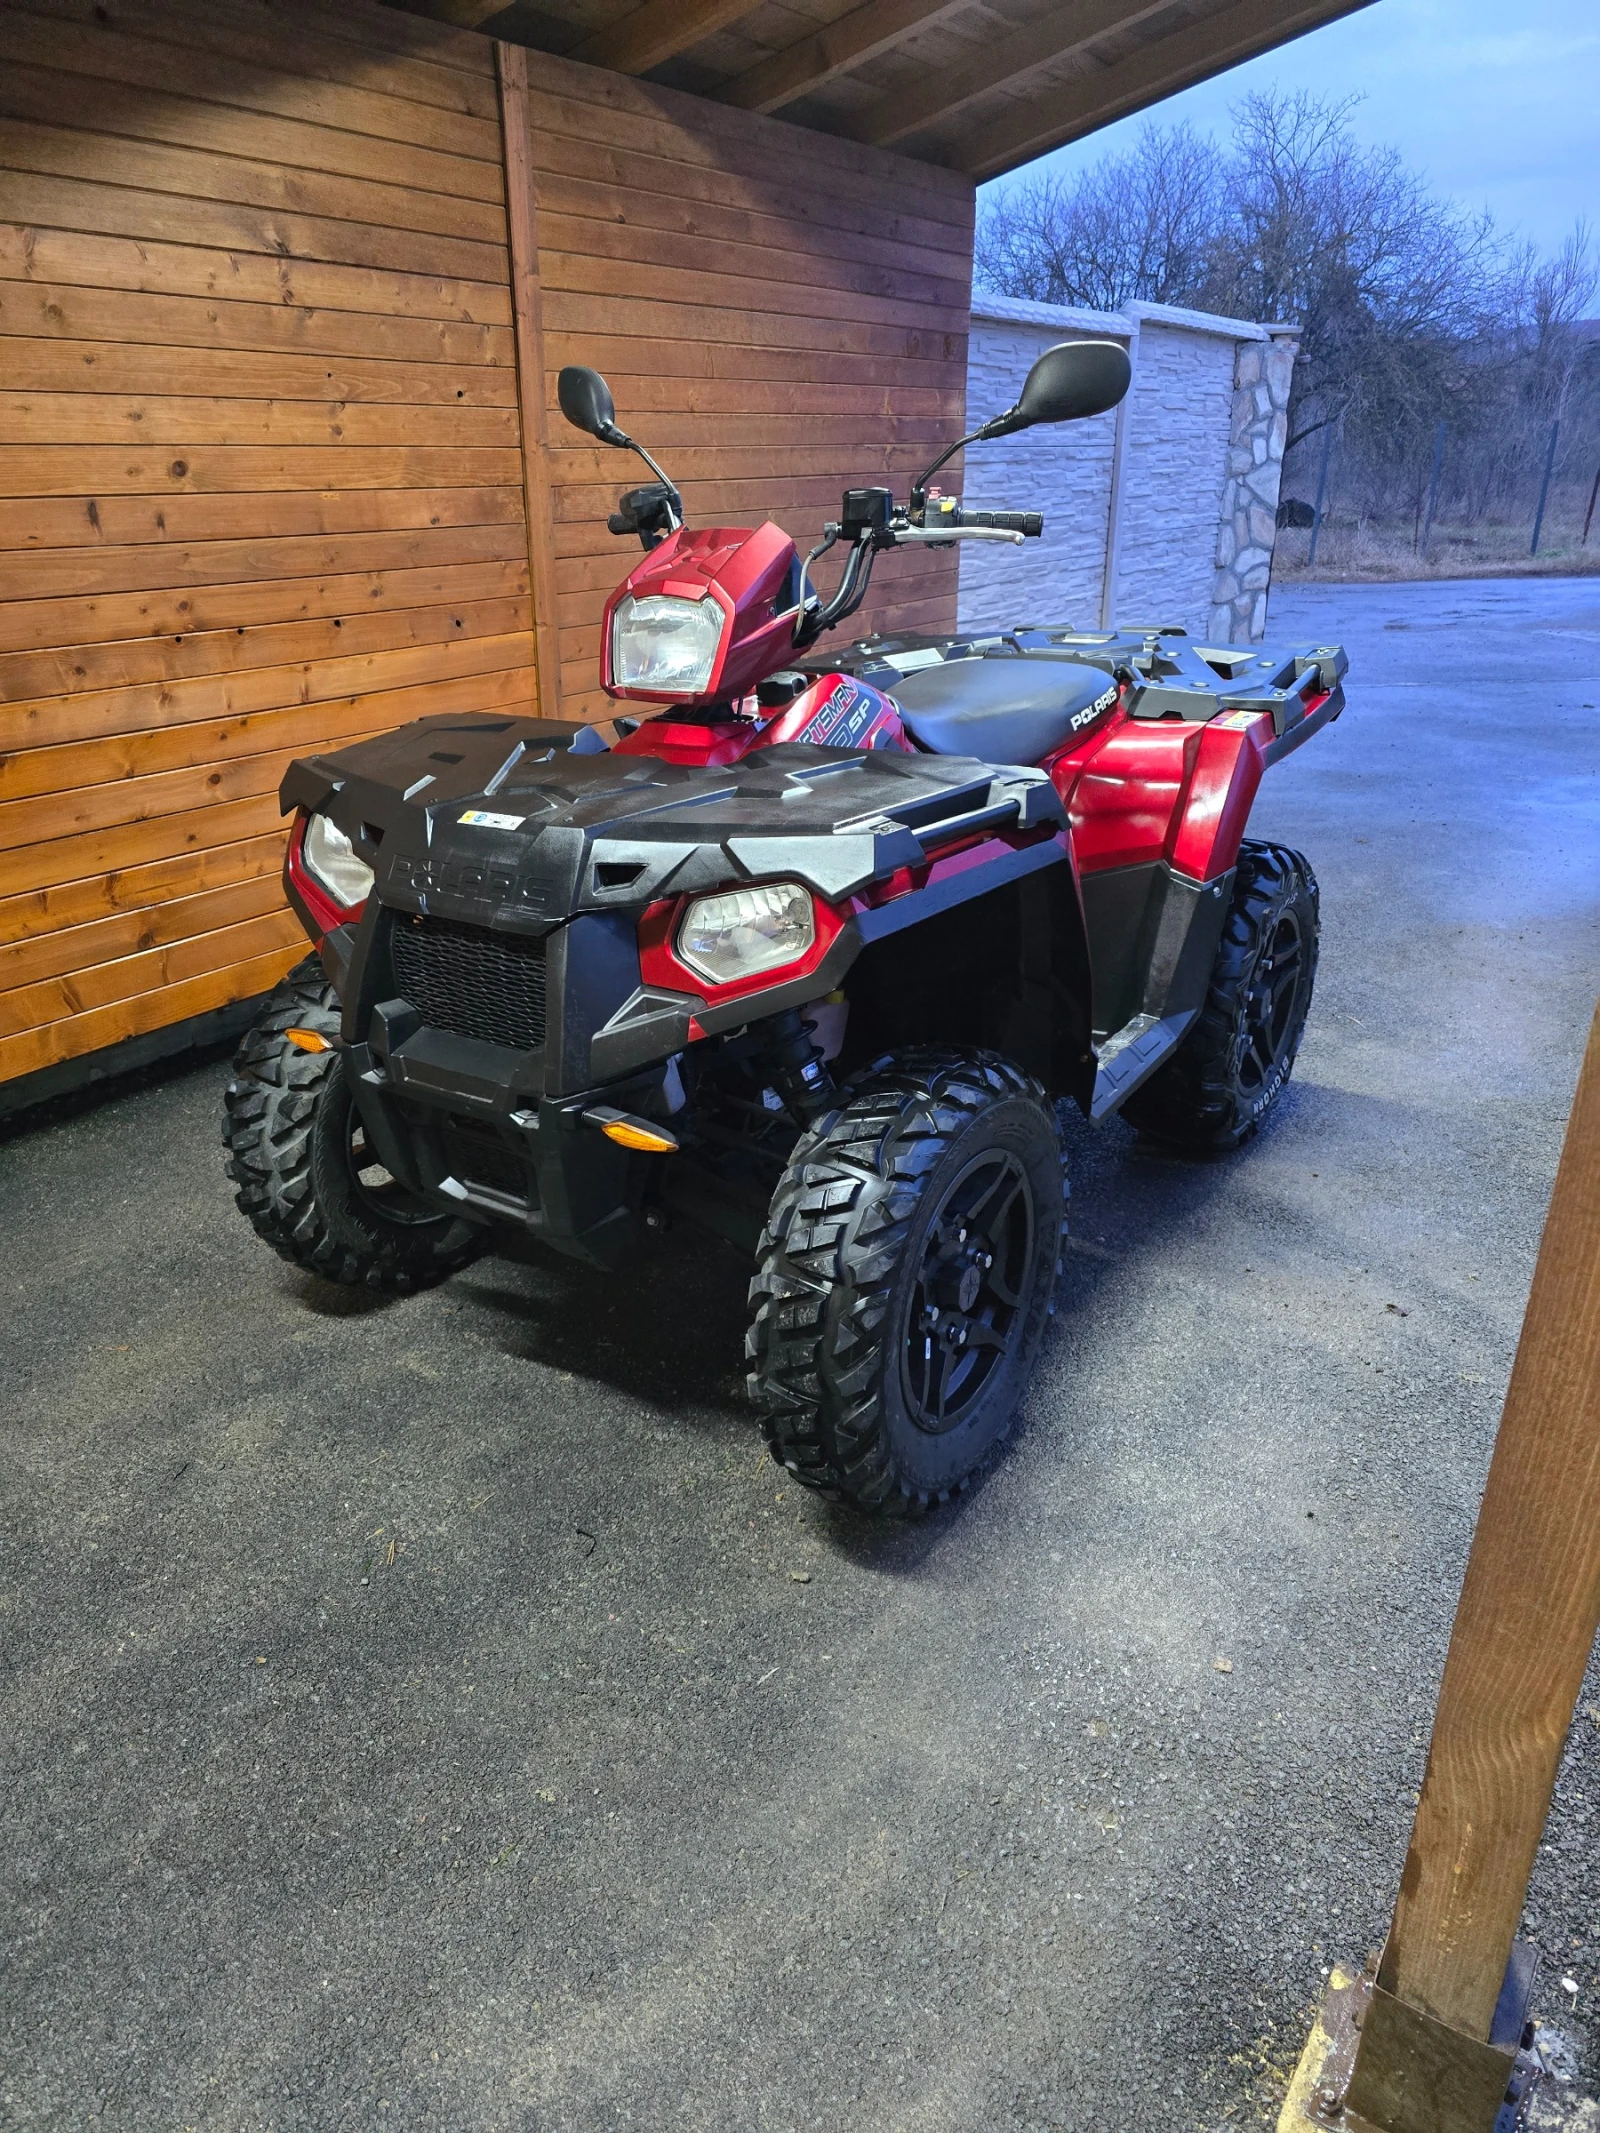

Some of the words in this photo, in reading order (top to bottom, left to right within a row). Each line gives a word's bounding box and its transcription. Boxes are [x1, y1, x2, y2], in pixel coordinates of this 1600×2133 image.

[849, 699, 870, 734] SP
[1070, 686, 1117, 731] POLARIS
[388, 854, 555, 902] POLARIS
[1253, 1055, 1289, 1115] BIGHORN
